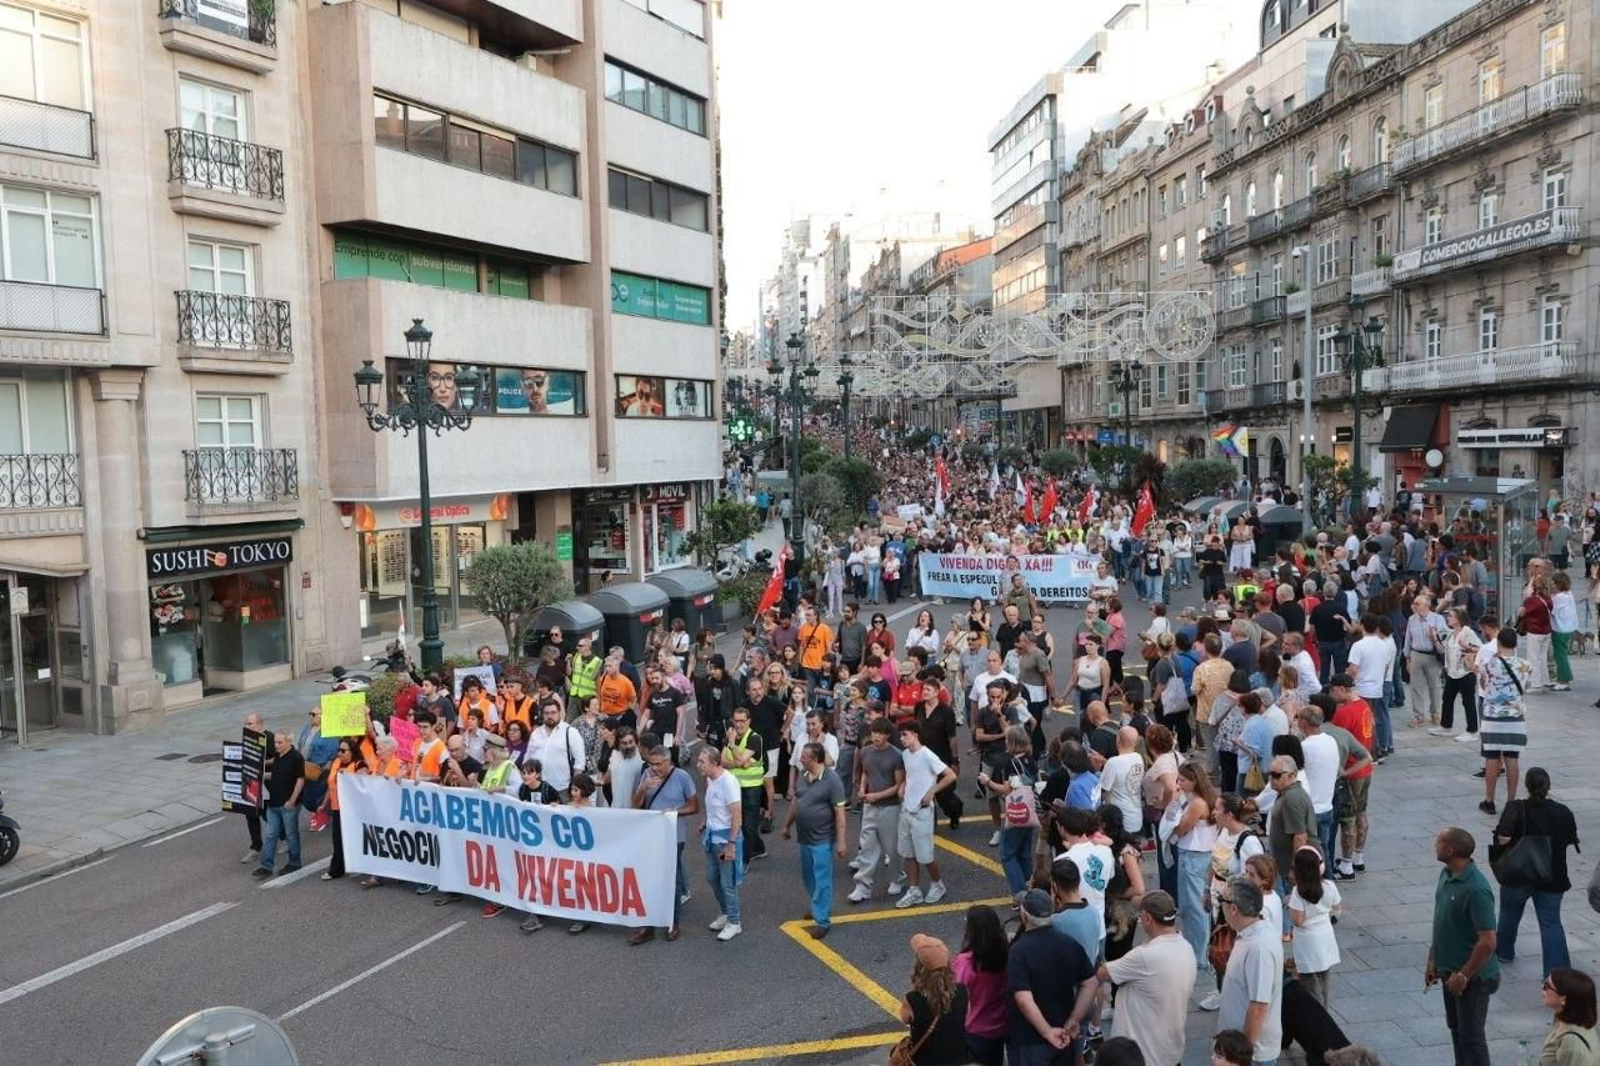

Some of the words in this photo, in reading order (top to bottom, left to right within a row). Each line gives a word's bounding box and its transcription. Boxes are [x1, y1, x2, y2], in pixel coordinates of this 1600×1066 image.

[1422, 216, 1551, 264] COMERCIOGALLEGO.ES
[335, 242, 386, 261] Emprende
[411, 255, 476, 275] subvenciones
[498, 387, 522, 396] POLICE
[152, 549, 210, 573] SUSHI
[230, 541, 290, 564] TOKYO
[940, 557, 983, 571] VIVENDA
[1025, 556, 1053, 572] XA!!!
[928, 571, 951, 582] FREAR
[953, 573, 958, 583] A
[960, 574, 999, 585] ESPECUL
[1040, 586, 1088, 598] DEREITOS
[400, 788, 543, 847] ACABEMOS
[550, 814, 594, 851] CO
[466, 840, 501, 893] DA
[514, 850, 647, 917] VIVENDA
